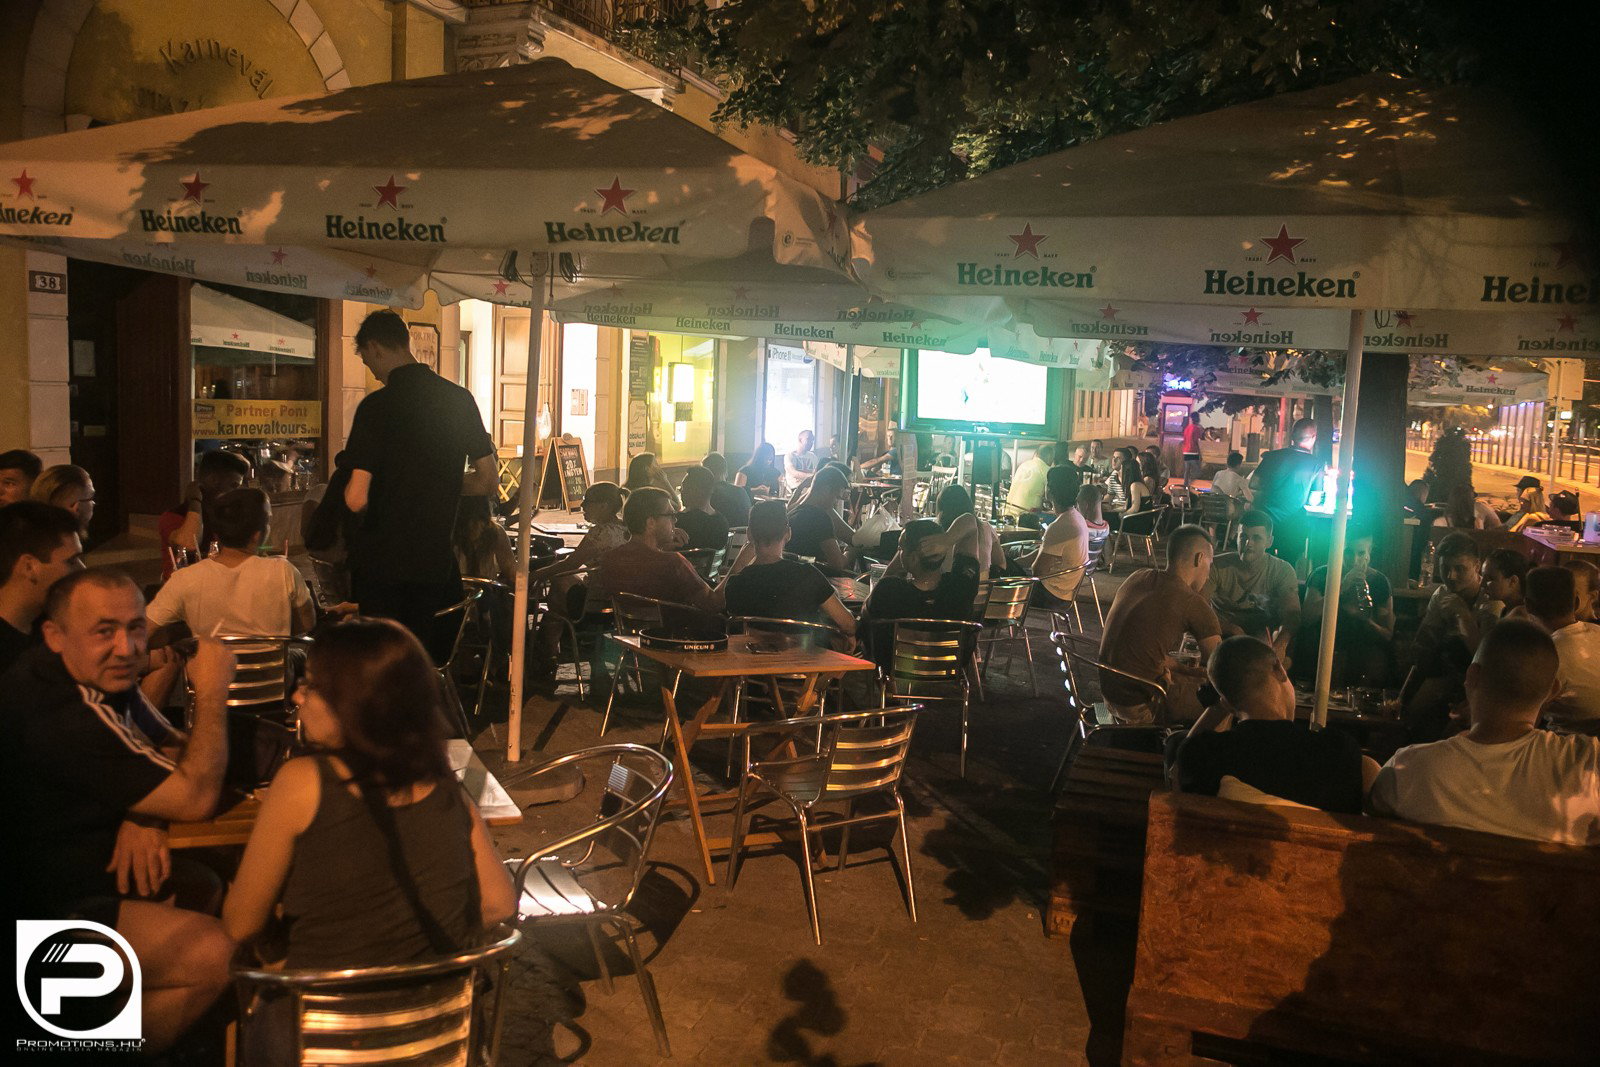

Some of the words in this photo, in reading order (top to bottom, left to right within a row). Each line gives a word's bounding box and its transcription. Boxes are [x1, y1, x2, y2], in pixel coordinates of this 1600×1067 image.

[140, 209, 242, 234] Heineken
[326, 215, 447, 242] Heineken
[544, 221, 681, 244] Heineken
[37, 275, 58, 290] 38
[957, 262, 1094, 289] Heineken
[1203, 269, 1357, 299] Heineken
[676, 317, 730, 332] Heineken
[774, 323, 834, 339] Heineken
[1466, 384, 1516, 396] Heineken
[226, 404, 275, 418] Partner
[280, 406, 308, 418] Pont
